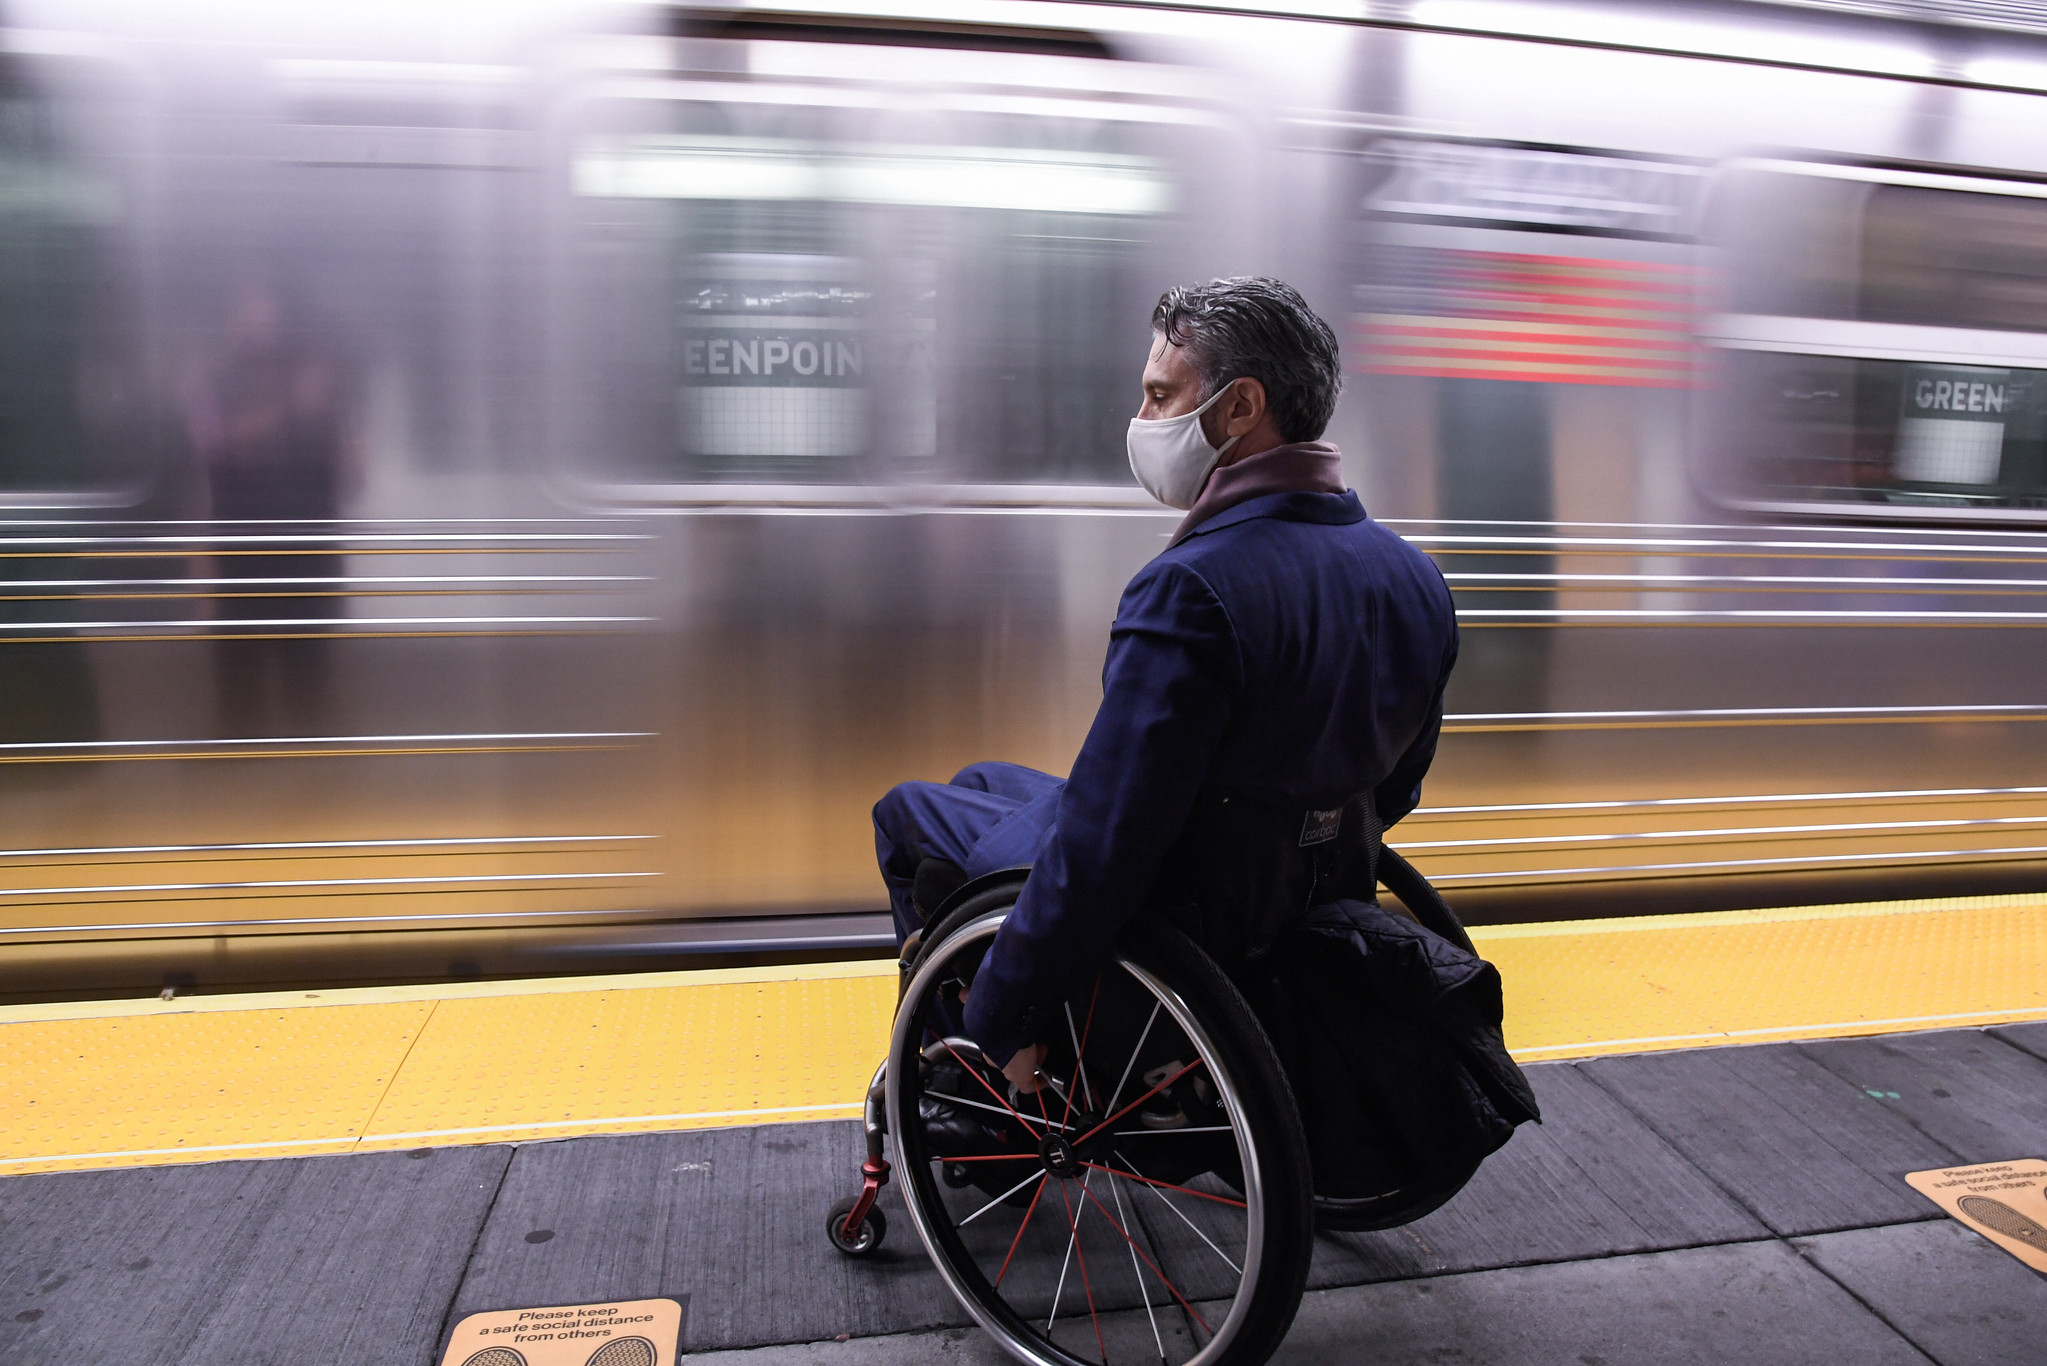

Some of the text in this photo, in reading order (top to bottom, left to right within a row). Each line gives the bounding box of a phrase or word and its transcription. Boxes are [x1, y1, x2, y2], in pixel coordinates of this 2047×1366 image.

[519, 1307, 618, 1321] Please keep
[479, 1313, 654, 1336] a safe social distance
[514, 1328, 612, 1343] from others
